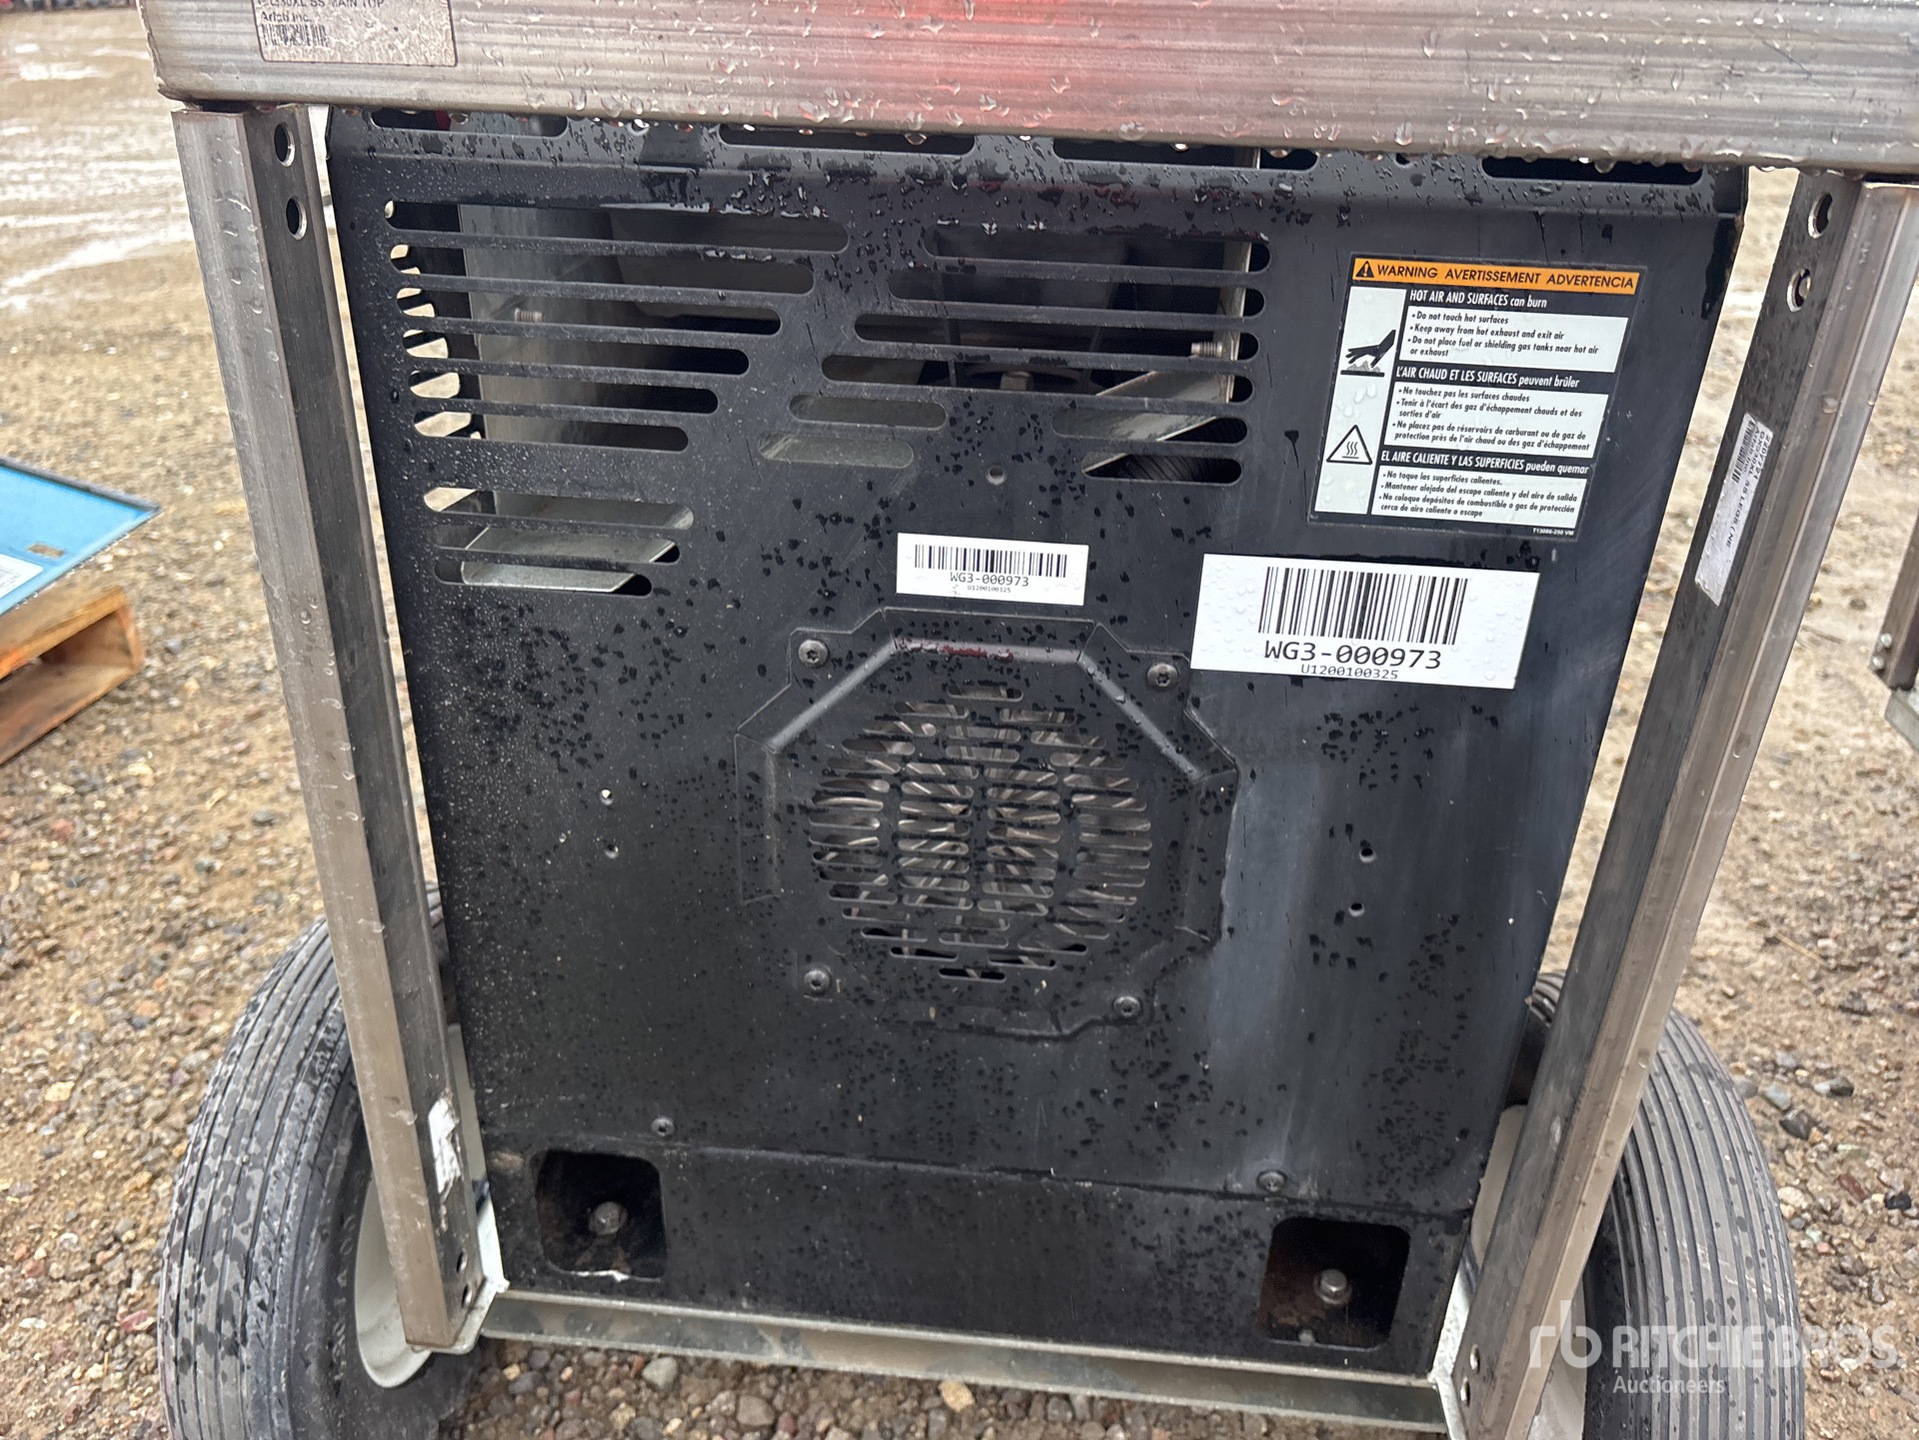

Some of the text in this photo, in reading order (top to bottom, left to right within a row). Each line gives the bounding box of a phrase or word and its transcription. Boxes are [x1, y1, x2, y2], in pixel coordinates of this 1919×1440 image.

[1377, 264, 1633, 288] WARNING AVERTISSEMENT ADVERTENCIA
[1409, 289, 1547, 308] HOT AIR AND SURFACES can burn
[1416, 310, 1509, 324] Do not touch hot surfaces
[1414, 322, 1564, 340] Keep away from hot exhaust and exit air
[1411, 335, 1422, 344] Do
[1437, 336, 1456, 347] place
[1458, 337, 1473, 347] fuel
[1484, 339, 1516, 352] shielding
[1517, 343, 1531, 352] gas
[1532, 342, 1553, 352] tanks
[1573, 343, 1586, 353] hot
[1587, 345, 1599, 354] air
[1419, 347, 1449, 356] exhaust
[1418, 367, 1448, 380] CHAUD
[1448, 368, 1460, 380] ET
[1460, 369, 1475, 381] LES
[1476, 370, 1518, 384] SURFACES
[1517, 376, 1553, 387] peuvent
[1402, 386, 1530, 402] Ne touchez pas les surfaces chaudes
[1398, 409, 1423, 418] sorties
[1401, 397, 1418, 406] Tenir
[1450, 400, 1463, 410] des
[1463, 404, 1477, 412] gaz
[1533, 405, 1558, 416] chauds
[1569, 407, 1582, 417] des
[1396, 420, 1407, 428] Ne
[1407, 420, 1430, 431] placez
[1431, 424, 1444, 432] pas
[1446, 422, 1455, 431] de
[1494, 425, 1503, 435] de
[1504, 427, 1539, 437] carburant
[1551, 429, 1560, 438] de
[1576, 430, 1586, 440] de
[1394, 432, 1430, 440] protection
[1448, 433, 1458, 442] de
[1474, 435, 1496, 445] chaud
[1507, 437, 1520, 446] des
[1521, 440, 1535, 449] gaz
[1380, 450, 1589, 475] EL AIRE CALIENTE Y LAS SUPERFICIES pueden quemar
[1386, 470, 1397, 478] No
[1398, 471, 1418, 481] toque
[1419, 471, 1430, 480] las
[1432, 473, 1468, 483] superficies
[1384, 481, 1418, 491] Mantener
[1419, 483, 1444, 494] alejado
[1445, 484, 1458, 493] del
[1458, 488, 1482, 497] escape
[1483, 488, 1510, 497] caliente
[1517, 489, 1530, 498] del
[1530, 491, 1544, 500] aire
[1545, 491, 1555, 500] de
[1556, 492, 1577, 502] salida
[1382, 492, 1393, 500] No
[1394, 492, 1420, 504] coloque
[1456, 496, 1465, 505] de
[1466, 498, 1507, 508] combustible
[1528, 501, 1538, 510] de
[1399, 503, 1408, 512] de
[1409, 504, 1424, 512] aire
[1425, 505, 1452, 514] caliente
[1459, 509, 1483, 517] escape
[950, 572, 1029, 587] WG3-000973
[1264, 640, 1442, 670] WG3-000973
[1301, 664, 1399, 680] U1200100325
